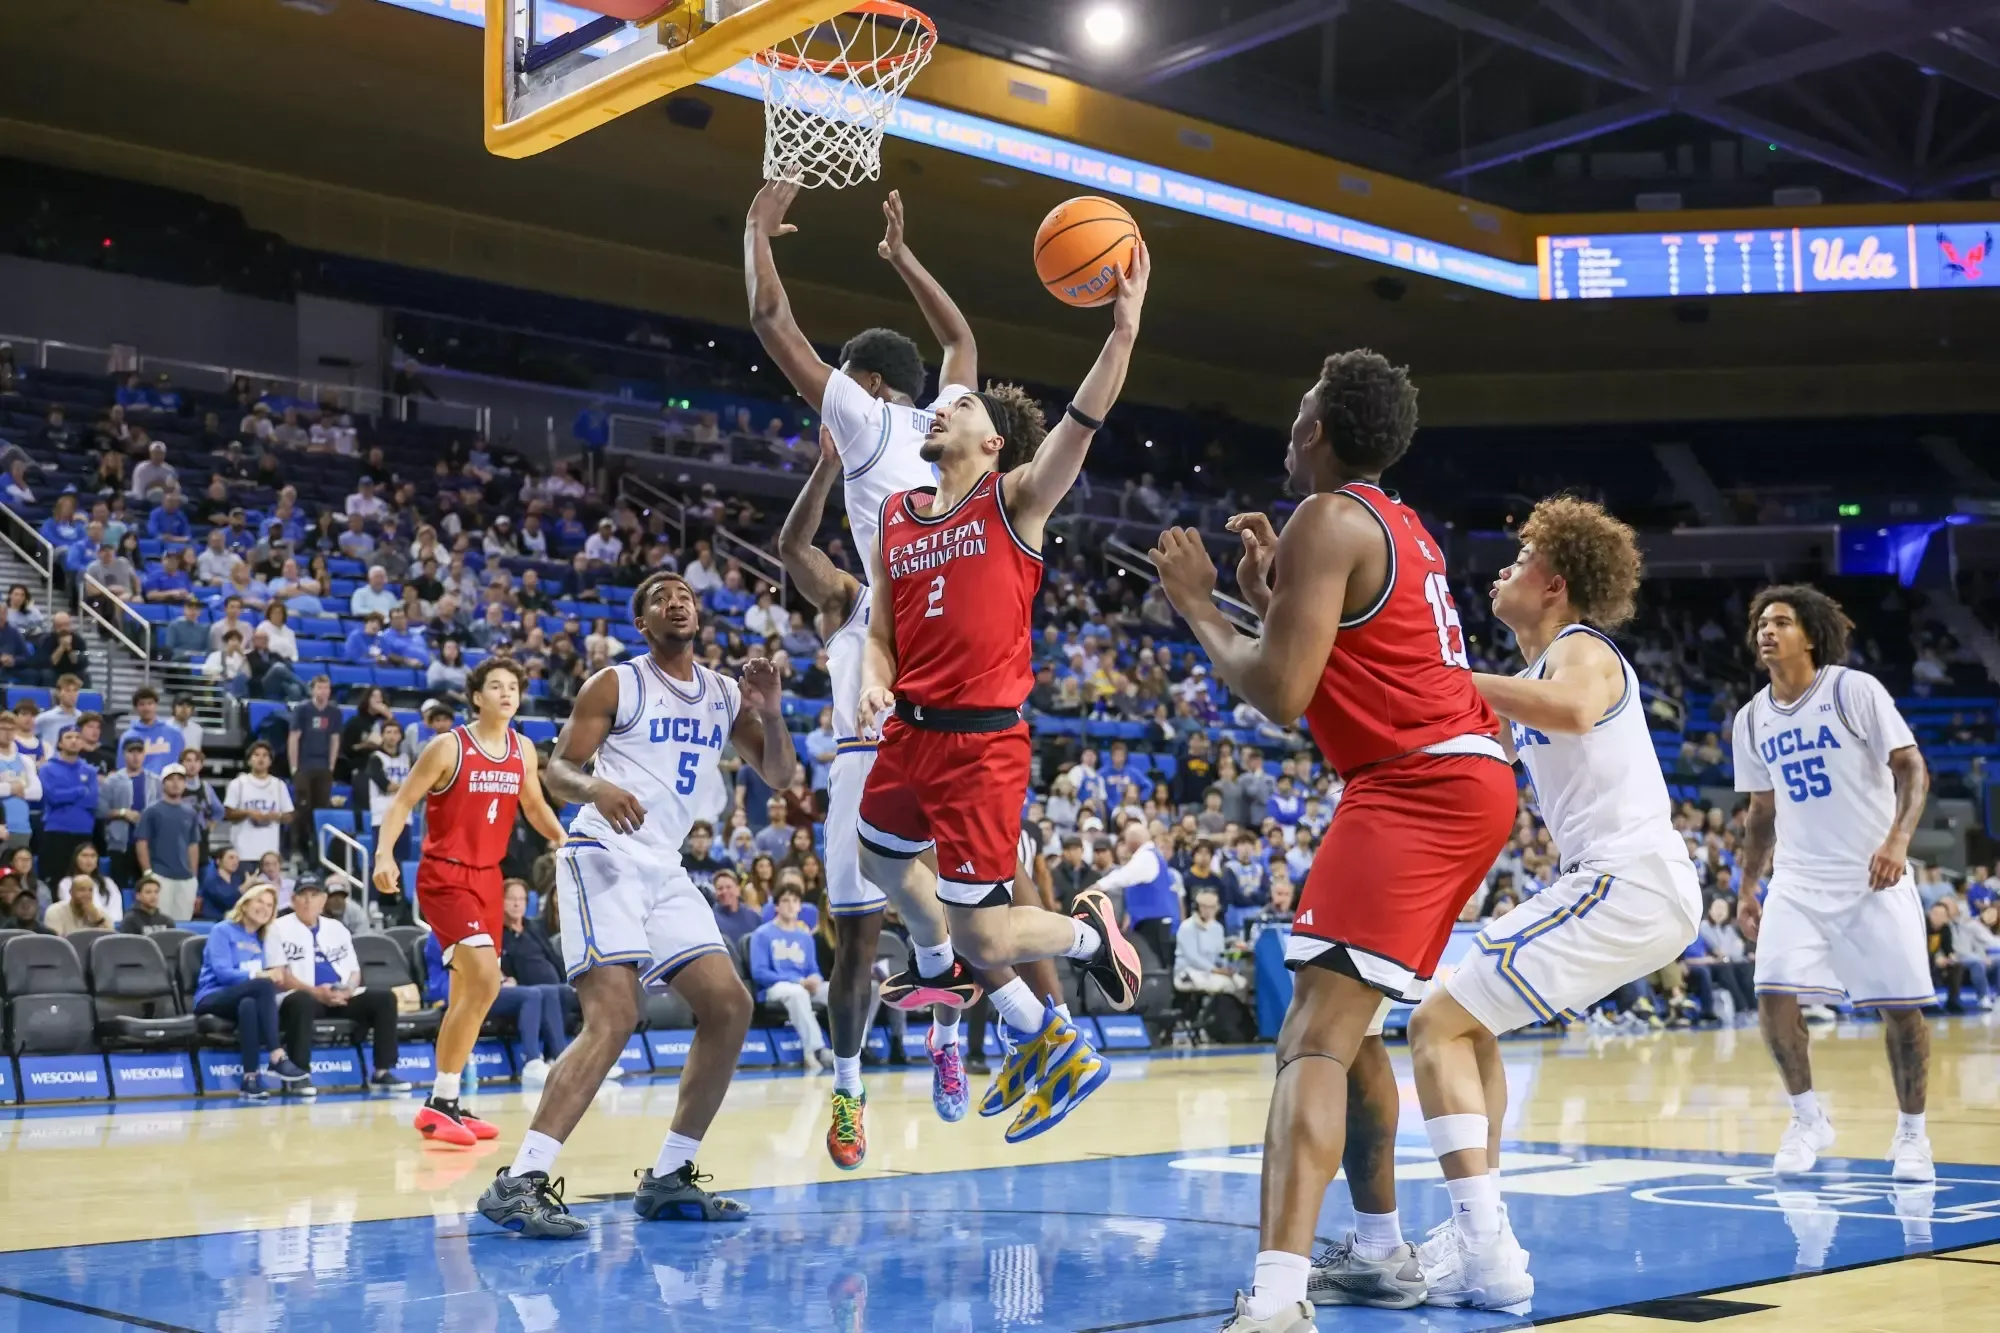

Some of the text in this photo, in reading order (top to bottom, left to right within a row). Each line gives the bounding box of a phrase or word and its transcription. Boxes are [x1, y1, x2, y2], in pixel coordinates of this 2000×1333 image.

[1810, 236, 1898, 281] Ucla
[1063, 265, 1115, 299] UCLA
[889, 519, 985, 563] EASTERN
[890, 538, 987, 580] WASHINGTON
[924, 575, 946, 618] 2
[649, 717, 723, 750] UCLA
[1760, 724, 1841, 764] UCLA
[469, 770, 521, 784] EASTERN
[675, 751, 700, 796] 5
[1781, 755, 1832, 803] 55
[487, 798, 499, 825] 4
[31, 1071, 85, 1085] WESCOM
[120, 1066, 172, 1081] WESCOM
